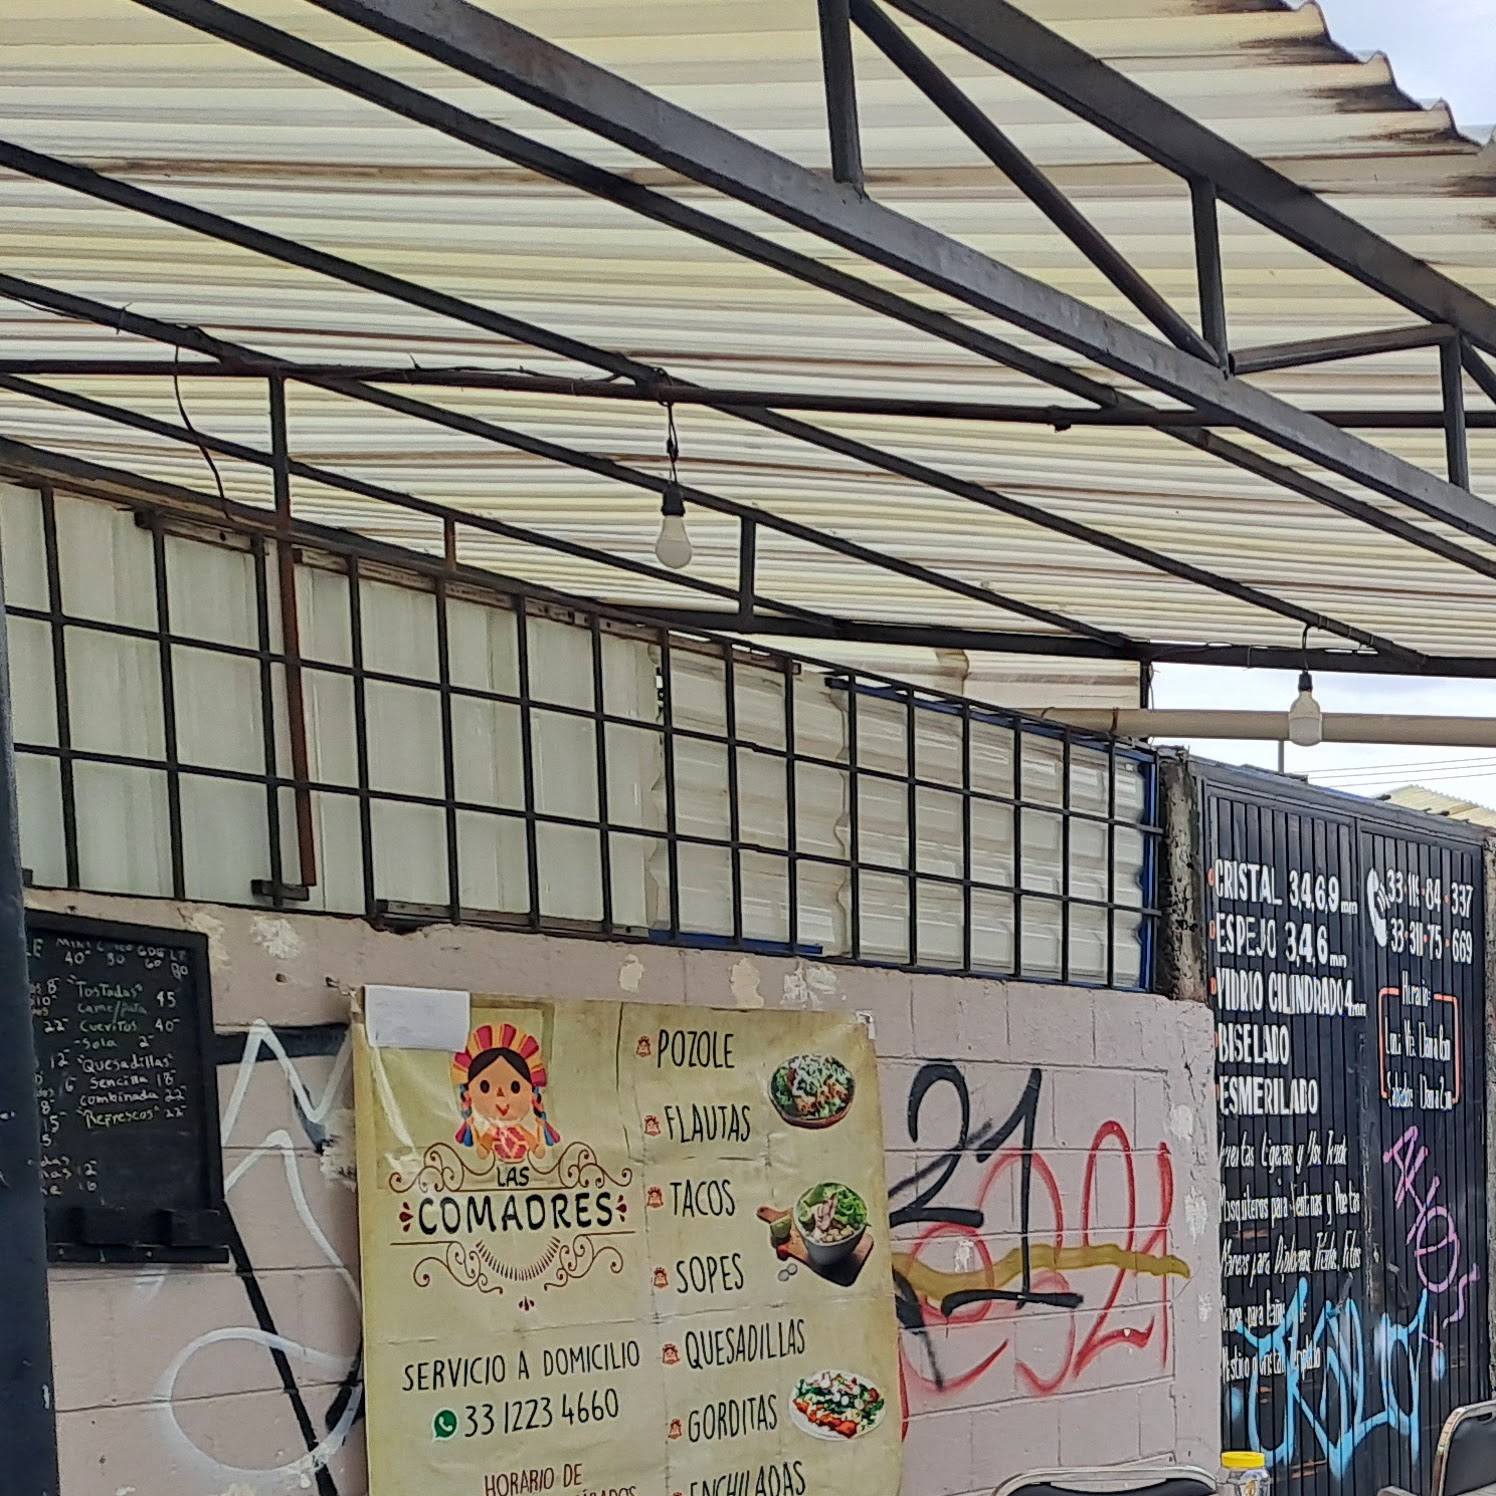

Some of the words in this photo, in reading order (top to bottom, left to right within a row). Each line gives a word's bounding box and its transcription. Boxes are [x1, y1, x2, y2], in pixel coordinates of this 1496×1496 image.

[1215, 859, 1283, 905] CRISTAL
[1216, 912, 1277, 959] ESPEJO
[1216, 966, 1264, 1012] VIDRIO
[1268, 971, 1345, 1017] CILINDRADO
[656, 1029, 735, 1069] POZOLE
[1218, 1022, 1290, 1065] BISELADO
[1219, 1075, 1318, 1115] ESMERILADO
[664, 1103, 751, 1143] FLAUTAS
[496, 1166, 530, 1187] LAS
[418, 1191, 613, 1235] COMADRES
[669, 1179, 736, 1218] TACOS
[676, 1253, 744, 1294] SOPES
[402, 1354, 506, 1391] SERVICIO
[518, 1350, 530, 1380] A
[543, 1340, 640, 1377] DOMICILIO
[685, 1318, 806, 1370] QUESADILLAS
[464, 1403, 495, 1437] 33
[504, 1397, 553, 1434] 1223
[562, 1387, 619, 1425] 4660
[688, 1393, 778, 1443] GORDITAS
[563, 1463, 583, 1488] DE
